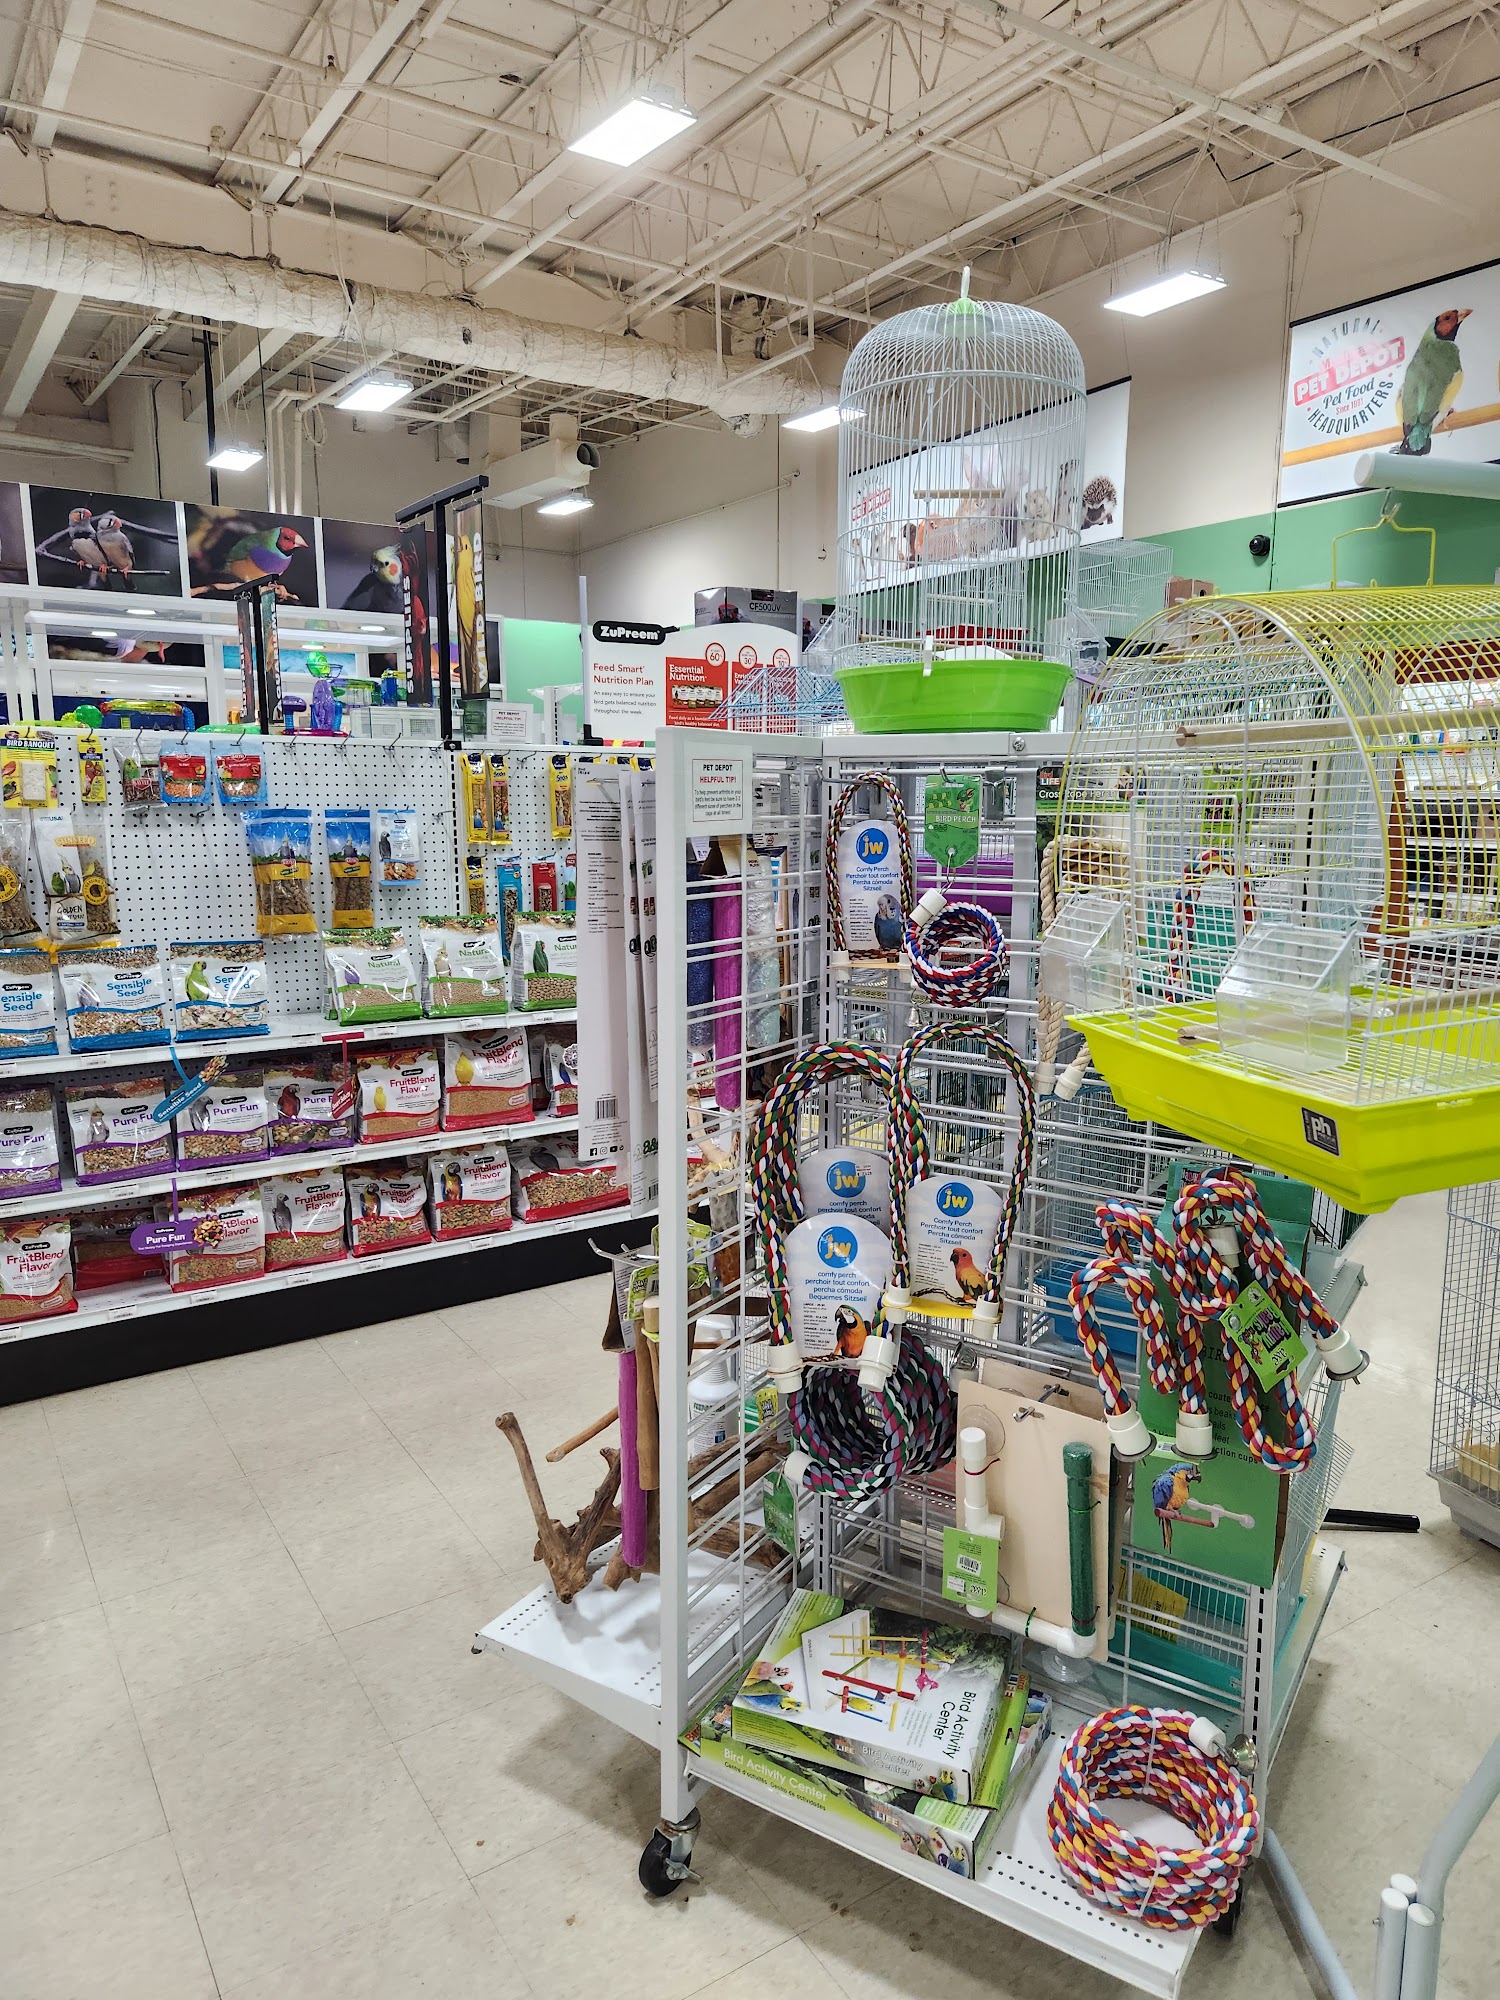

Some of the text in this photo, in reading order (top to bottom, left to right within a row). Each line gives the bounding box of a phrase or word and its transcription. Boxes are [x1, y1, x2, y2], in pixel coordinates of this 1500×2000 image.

[1312, 317, 1380, 358] NATURAL
[1295, 370, 1330, 402] PET
[1335, 341, 1403, 385] DEPOT
[1323, 377, 1375, 409] Pet Food
[1308, 381, 1394, 435] HEADQUARTERS
[1336, 402, 1350, 415] Since
[474, 531, 489, 690] WILD BIRD
[749, 602, 782, 612] CF500UV
[404, 575, 415, 694] SUPPLIES
[600, 625, 660, 641] ZuPreem
[593, 663, 643, 673] Feed Smart
[669, 664, 704, 675] Essential
[593, 675, 654, 686] Nutrition Plan
[669, 673, 706, 682] Nutrition
[593, 707, 620, 715] throughout
[23, 740, 55, 749] BANQUET
[1038, 789, 1062, 799] Cross
[935, 815, 976, 823] BIRD PERCH
[862, 835, 885, 856] jw
[57, 905, 83, 915] GOLDEN
[368, 959, 401, 968] Natural
[107, 978, 152, 991] Sensible
[0, 992, 42, 1002] ensible
[116, 987, 145, 998] Seed
[3, 1002, 34, 1012] Seed
[390, 1074, 436, 1088] FruitBlend
[158, 1082, 202, 1118] Sensible Seed
[304, 1096, 325, 1104] Pure
[213, 1104, 259, 1116] Pure Fun
[113, 1112, 153, 1127] Pure Fu
[1310, 1115, 1332, 1141] ph
[0, 1135, 45, 1147] ure Fun
[463, 1161, 508, 1175] FruitBlend
[474, 1171, 502, 1181] Flavor
[833, 1168, 859, 1191] jw
[380, 1184, 421, 1196] FruitBlend
[295, 1188, 344, 1205] FruitBlend
[390, 1193, 416, 1203] Flavor
[942, 1187, 968, 1209] jw
[920, 1221, 946, 1230] Perchoir
[933, 1217, 953, 1226] Comfy
[223, 1227, 250, 1238] lavor
[927, 1229, 950, 1237] Percha
[146, 1233, 185, 1245] Pure Fun
[824, 1234, 852, 1259] jw
[6, 1249, 65, 1265] FruitBlend
[19, 1261, 53, 1273] Flavor
[817, 1271, 857, 1279] comfy perch
[805, 1277, 831, 1286] perchoir
[832, 1278, 846, 1286] tout
[836, 1286, 863, 1294] cómoda
[808, 1293, 868, 1302] Bequemes Sitzseil
[1207, 1391, 1231, 1403] coate
[1213, 1432, 1230, 1445] feet
[1004, 1673, 1018, 1698] LIFE
[932, 1700, 956, 1741] Center
[942, 1690, 977, 1760] Bird Activity
[836, 1744, 855, 1755] LIFE
[862, 1745, 924, 1772] Bird Activity
[873, 1758, 911, 1777] Center
[724, 1748, 828, 1802] Bird Activity Center
[724, 1761, 742, 1774] Centre
[770, 1781, 788, 1795] Centro
[796, 1794, 827, 1812] actividades
[874, 1810, 901, 1828] LIFE
